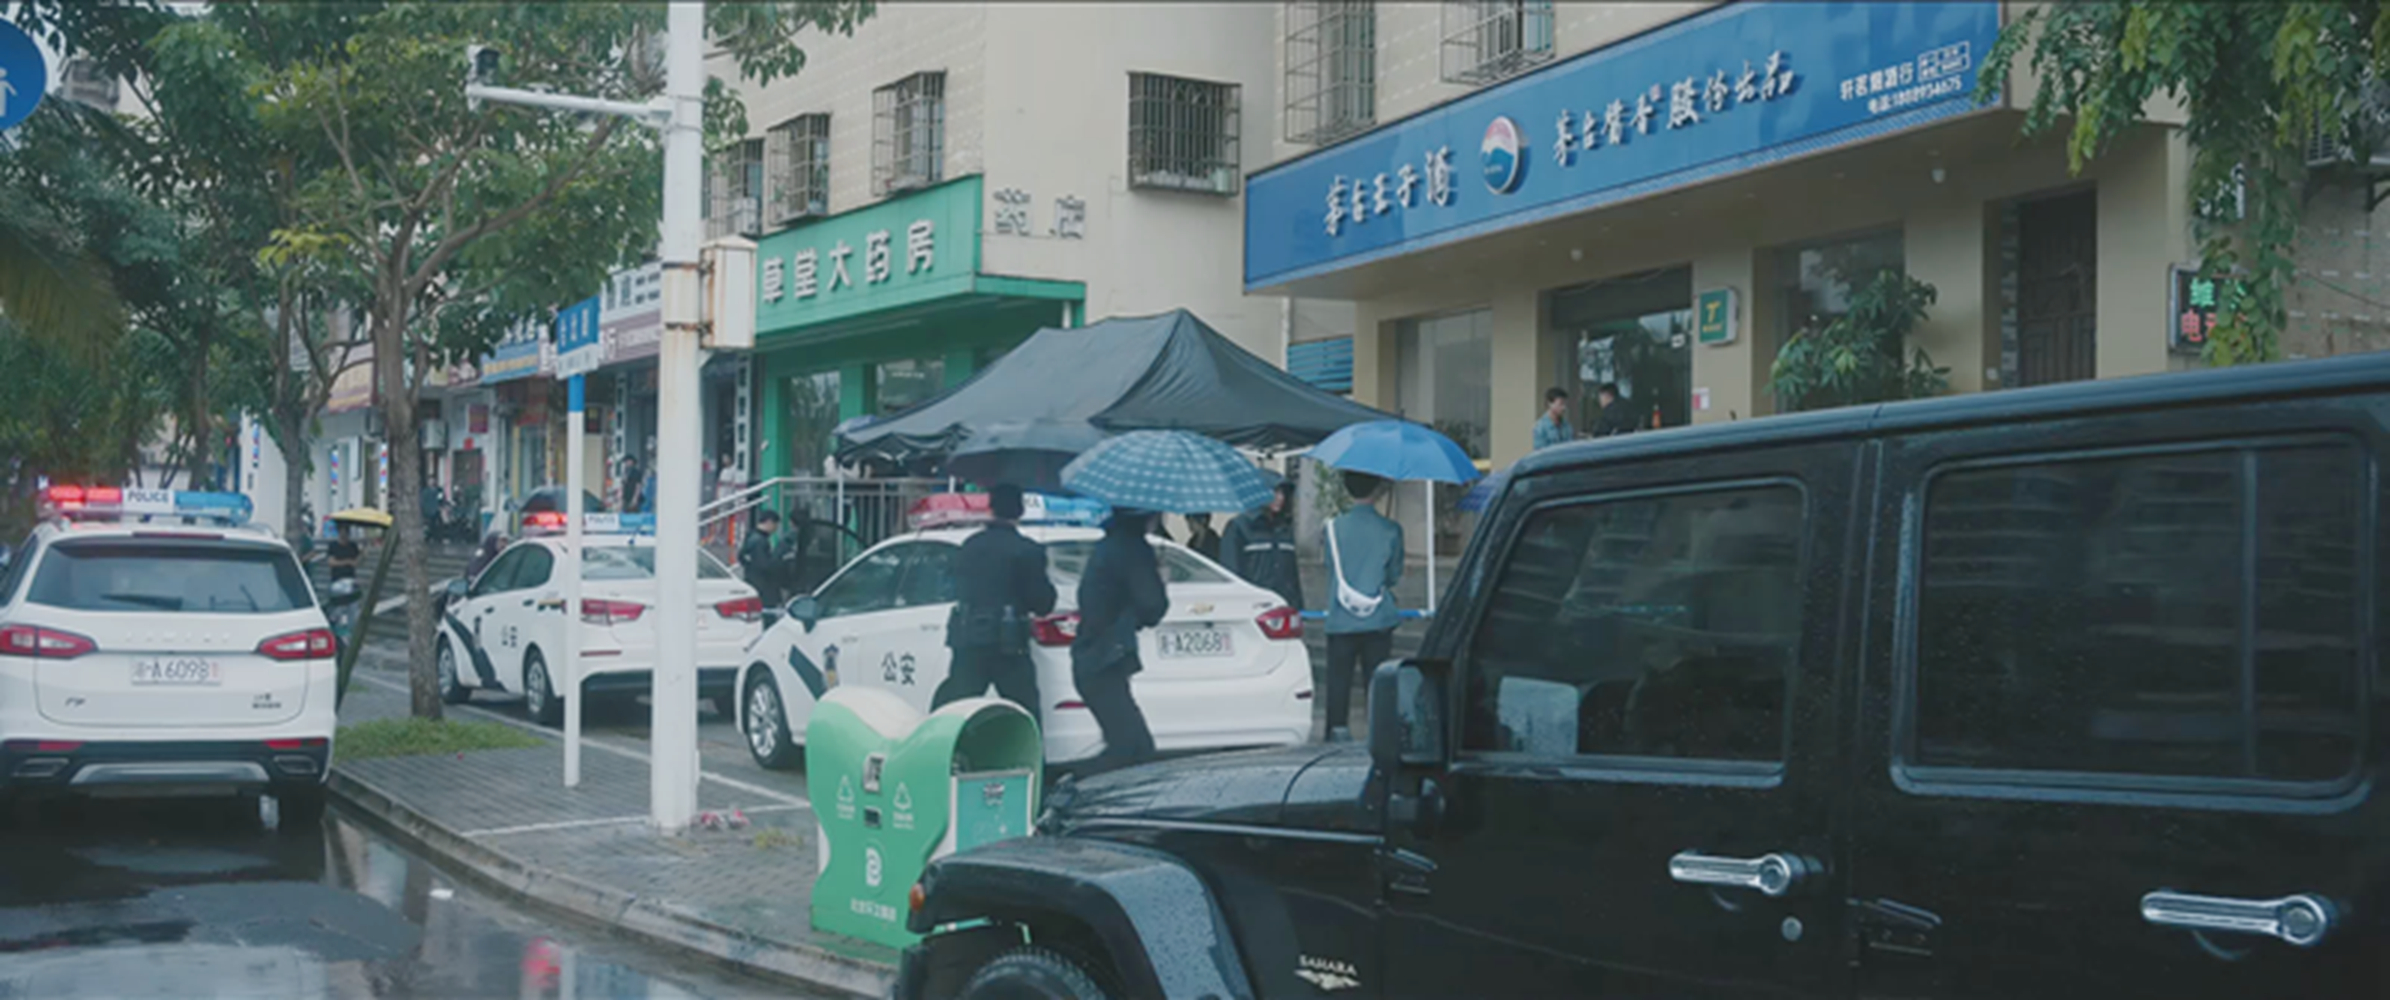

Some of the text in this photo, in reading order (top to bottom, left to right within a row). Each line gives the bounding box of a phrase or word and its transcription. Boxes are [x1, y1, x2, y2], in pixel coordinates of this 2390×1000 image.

[762, 219, 935, 305] 草堂大药房
[127, 490, 169, 503] POLICE
[882, 652, 916, 686] 公安
[1299, 954, 1358, 977] SAHARA
